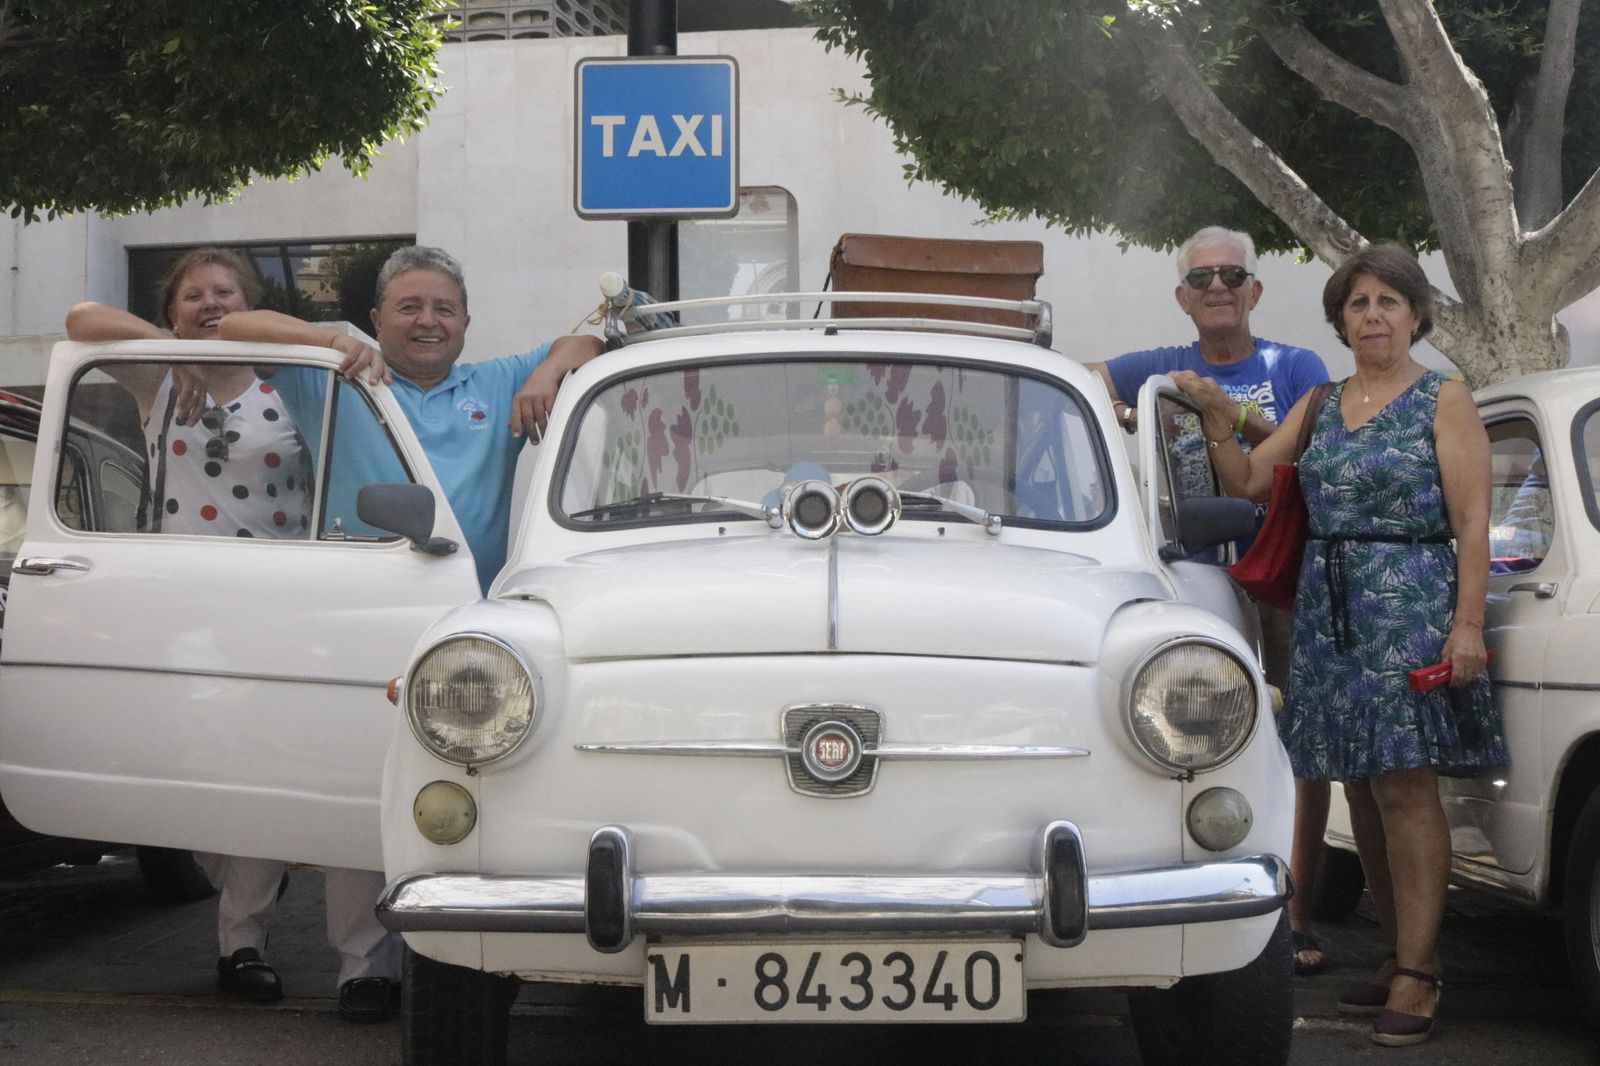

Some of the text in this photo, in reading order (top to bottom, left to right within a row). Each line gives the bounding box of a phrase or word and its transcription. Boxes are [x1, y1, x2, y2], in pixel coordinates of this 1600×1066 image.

[591, 114, 722, 157] TAXI
[819, 740, 846, 760] SEAT
[654, 953, 690, 1013] M
[754, 950, 1001, 1012] 843340
